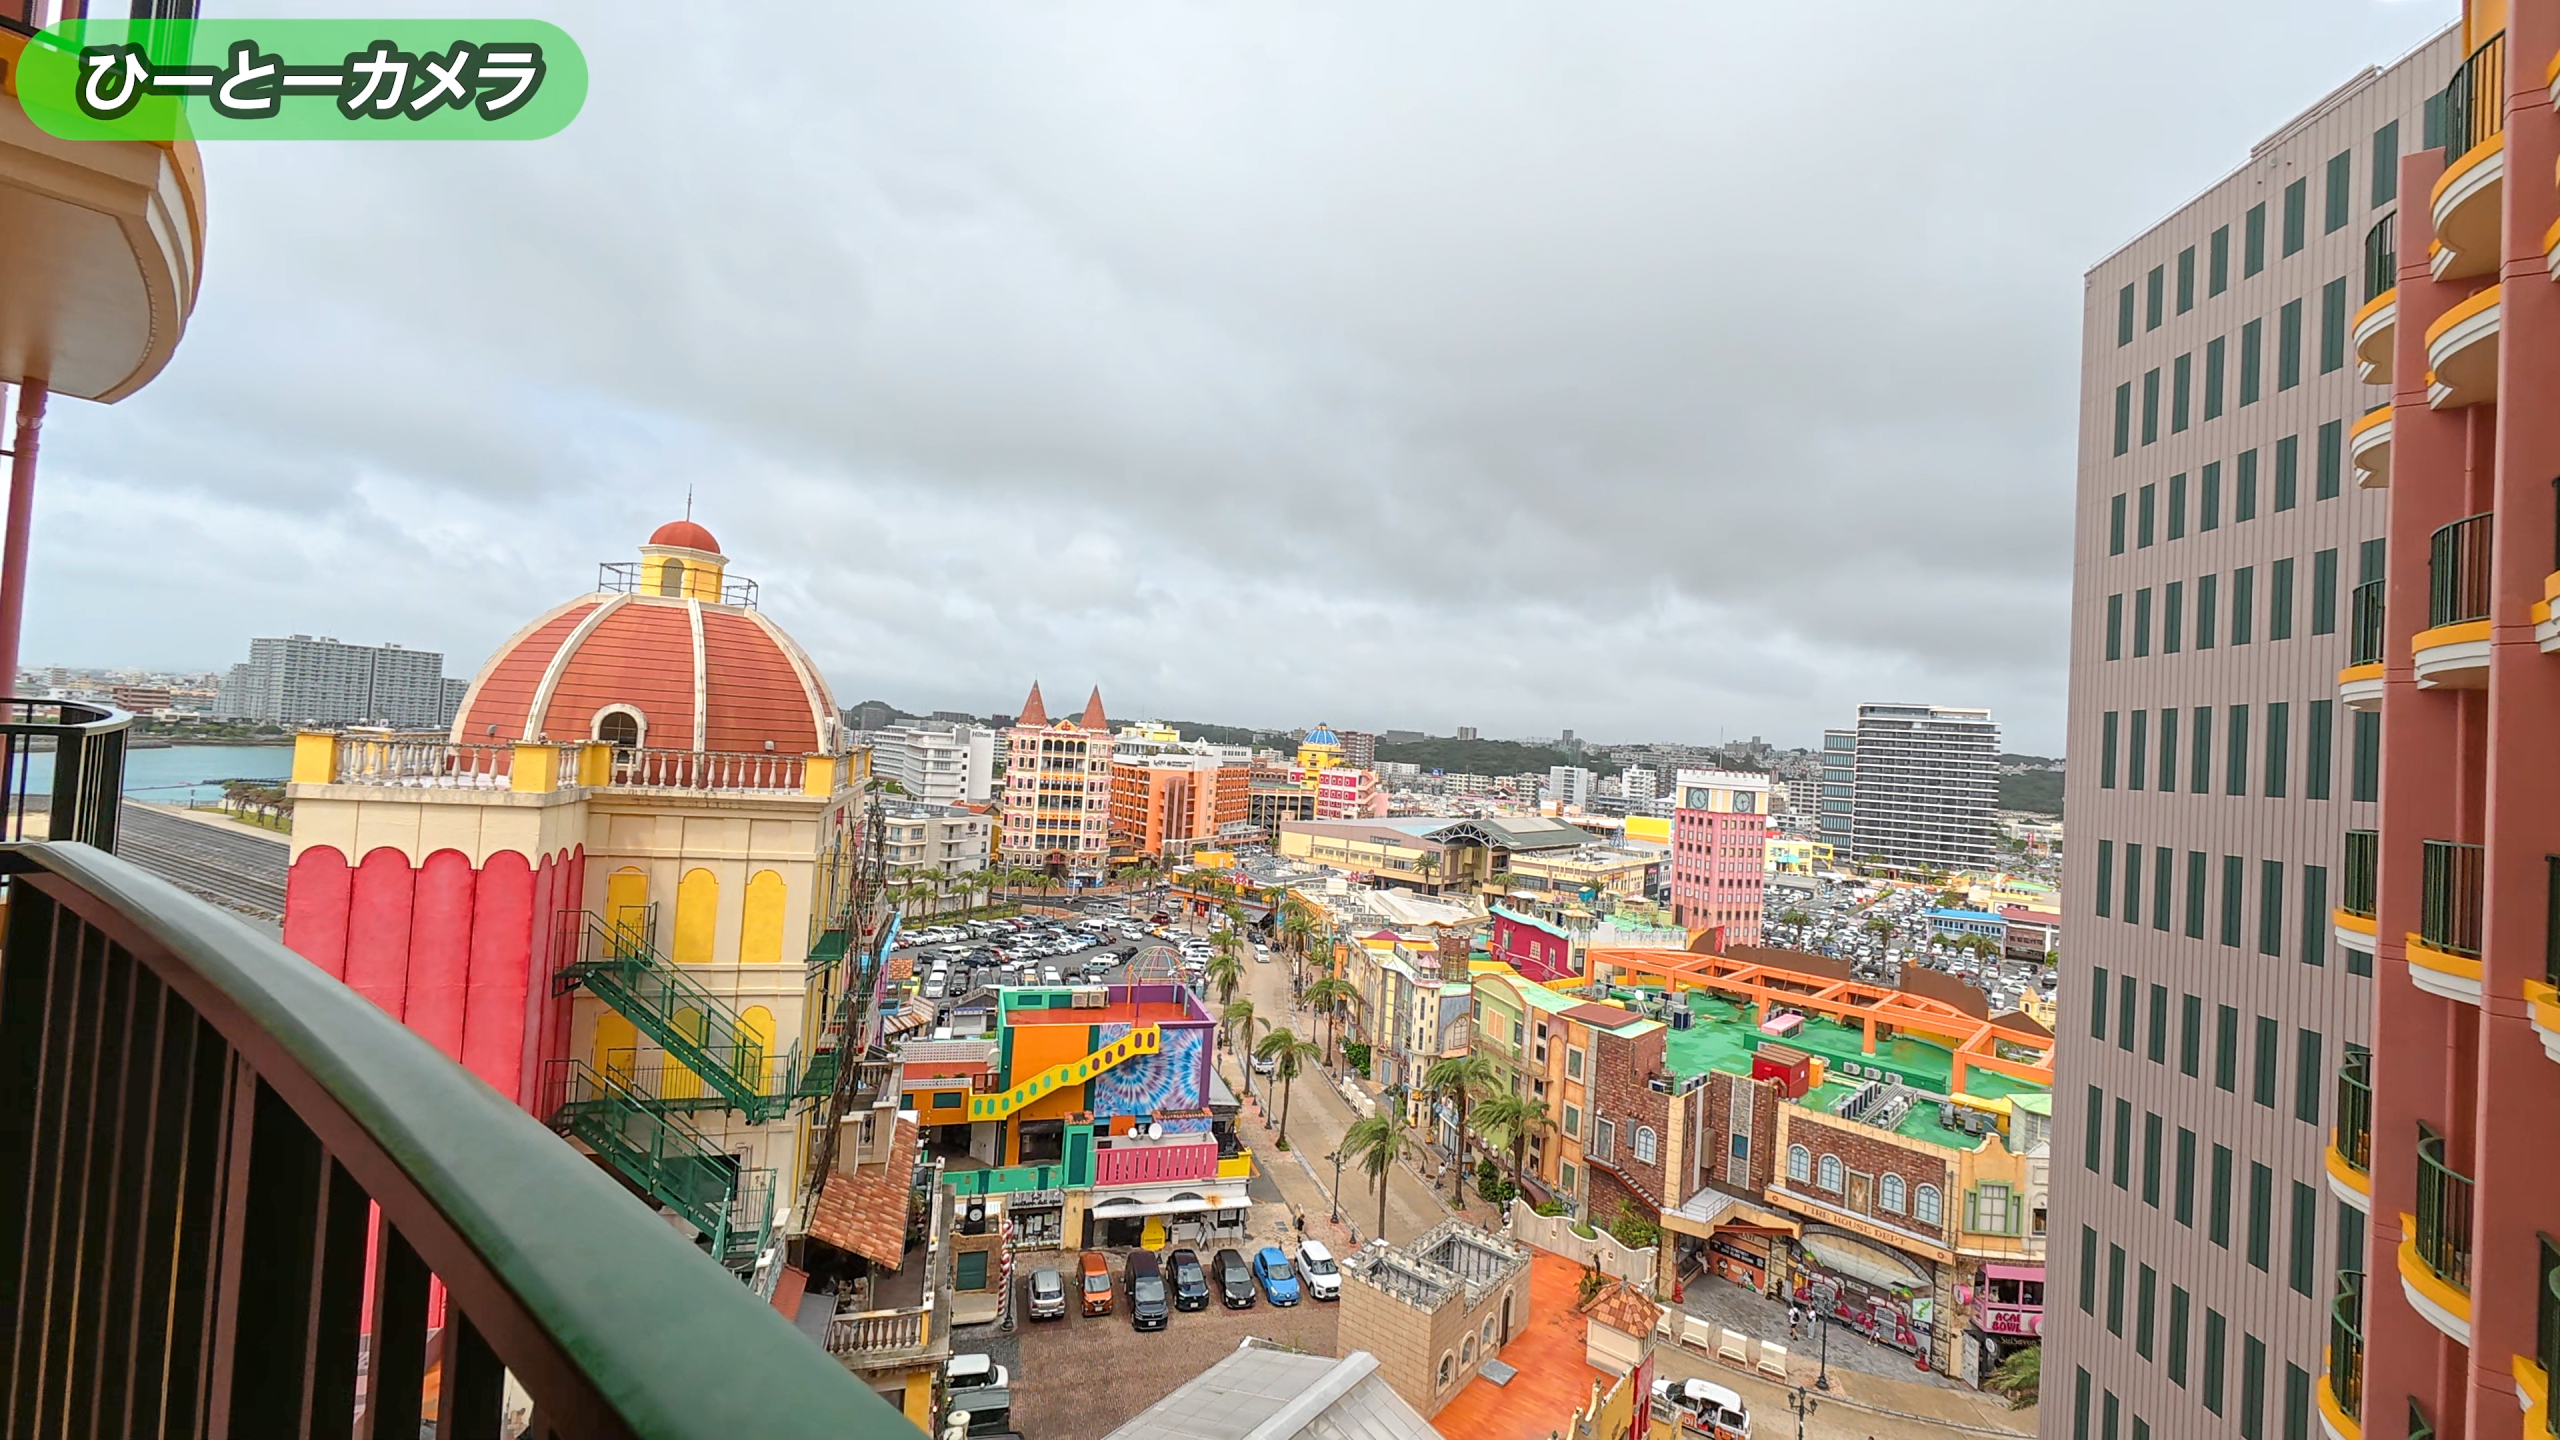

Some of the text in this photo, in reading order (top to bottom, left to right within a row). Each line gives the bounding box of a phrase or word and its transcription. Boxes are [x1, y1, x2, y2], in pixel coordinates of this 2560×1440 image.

[1803, 1204, 1907, 1246] FIRE HOUSE DEPT
[1991, 1321, 2022, 1333] BOWL
